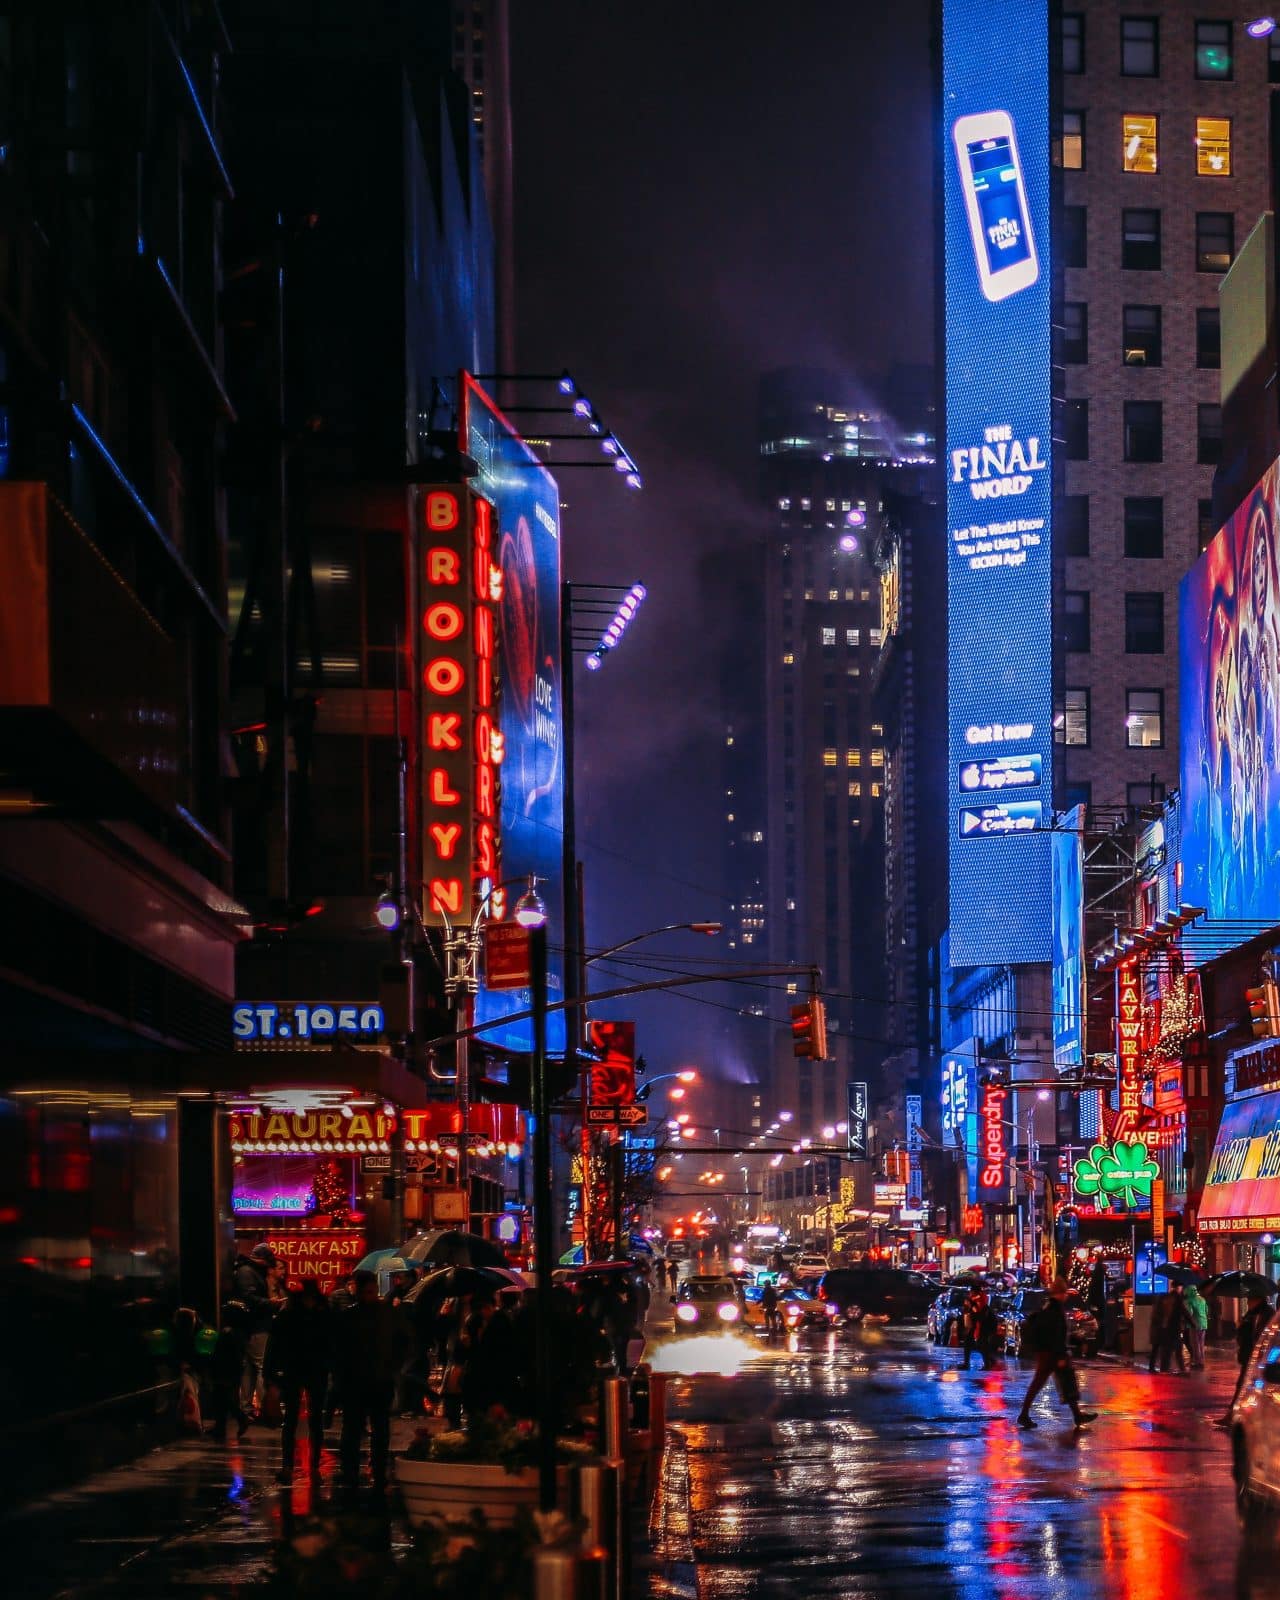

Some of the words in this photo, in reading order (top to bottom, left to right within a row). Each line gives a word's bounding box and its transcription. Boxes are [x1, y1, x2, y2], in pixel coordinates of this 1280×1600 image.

[985, 425, 1012, 442] THE
[952, 437, 1046, 482] FINAL
[970, 476, 1033, 500] WORD
[423, 492, 465, 914] BROOKLYN
[592, 1110, 610, 1119] ONE
[619, 1110, 639, 1119] WAY
[984, 1082, 1007, 1187] Superdry
[1123, 1131, 1174, 1146] TAVE
[367, 1157, 391, 1167] ONE
[270, 1240, 359, 1256] BREAKFAST
[289, 1260, 340, 1275] LUNCH
